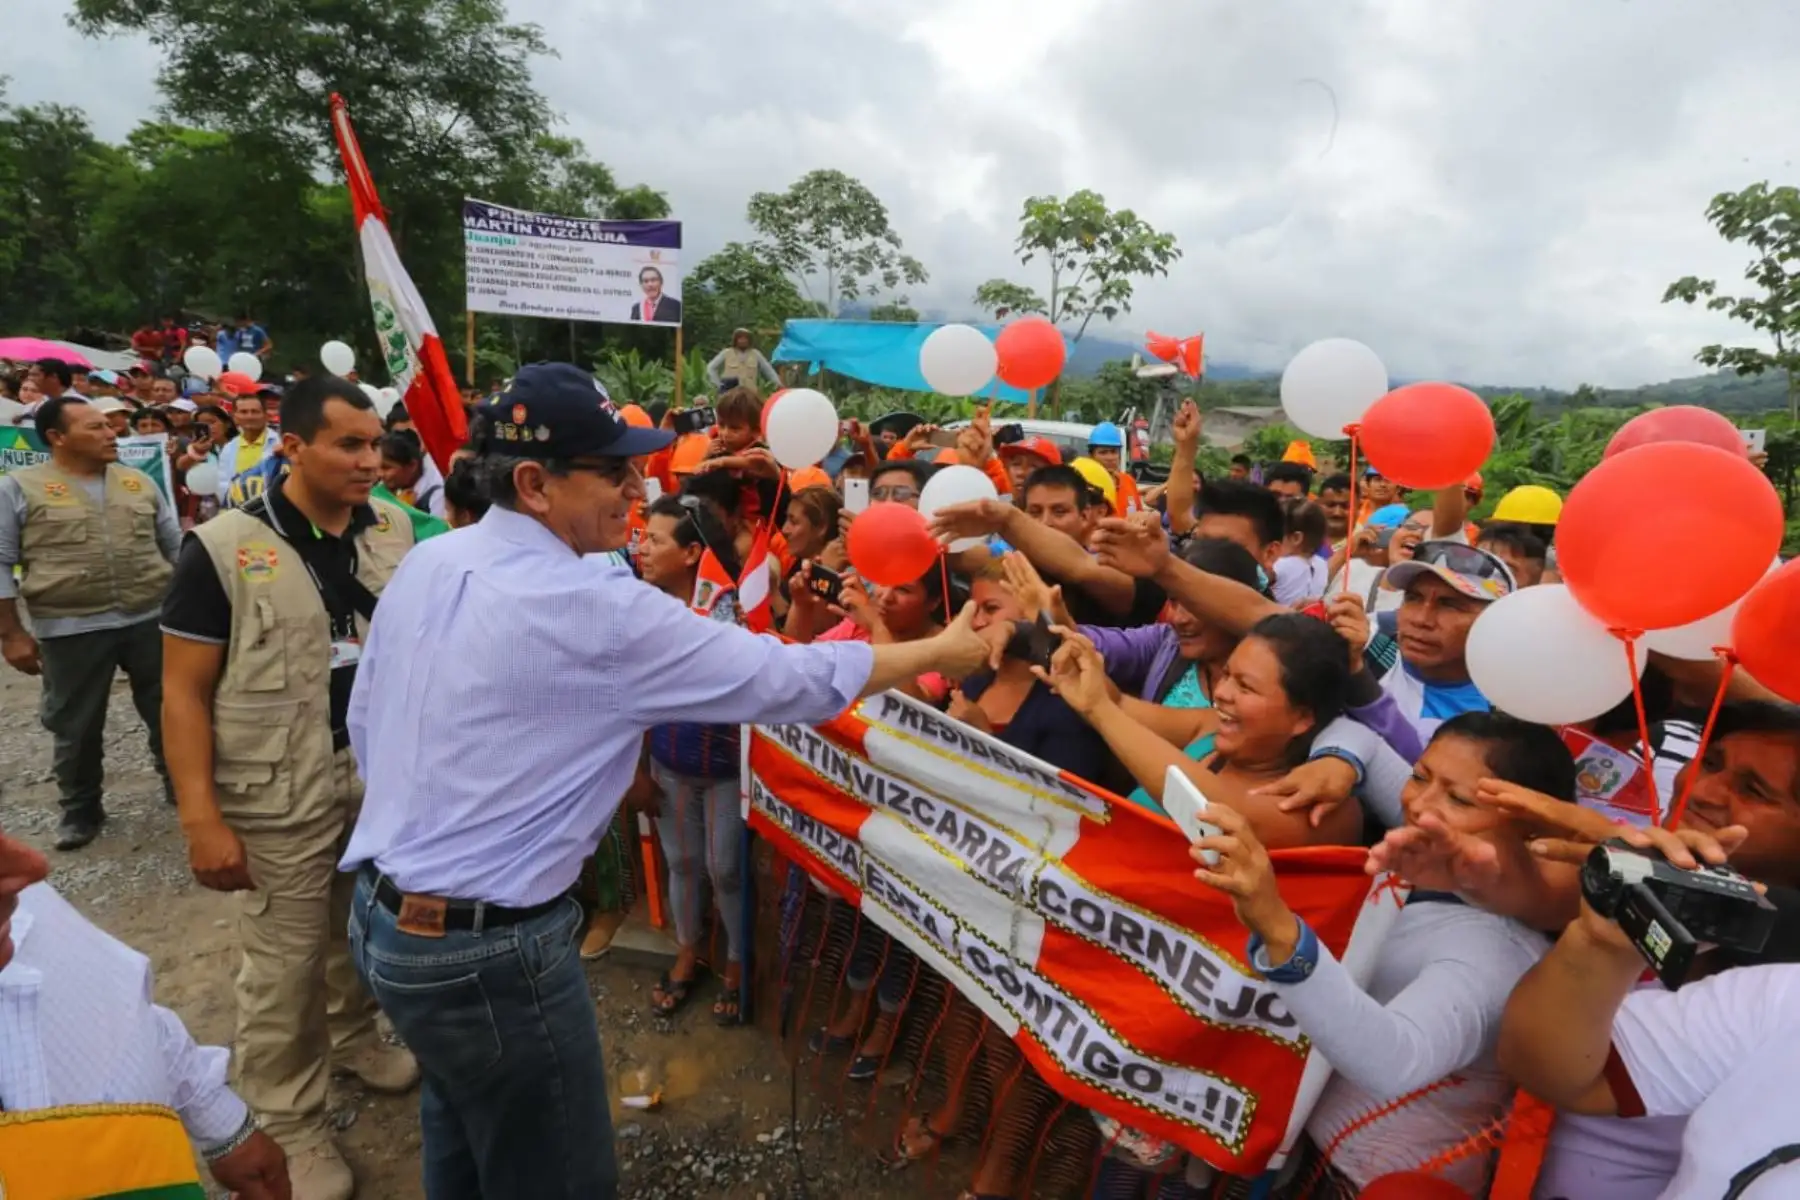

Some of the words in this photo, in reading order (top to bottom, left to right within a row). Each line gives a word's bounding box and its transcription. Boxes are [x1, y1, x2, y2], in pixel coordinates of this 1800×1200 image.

[536, 226, 629, 244] VIZCARRA
[880, 694, 1088, 800] PRESIDENTE
[766, 722, 851, 786] ARTIN
[851, 762, 1026, 898] VIZCARRA
[1038, 878, 1298, 1028] CORNEJO
